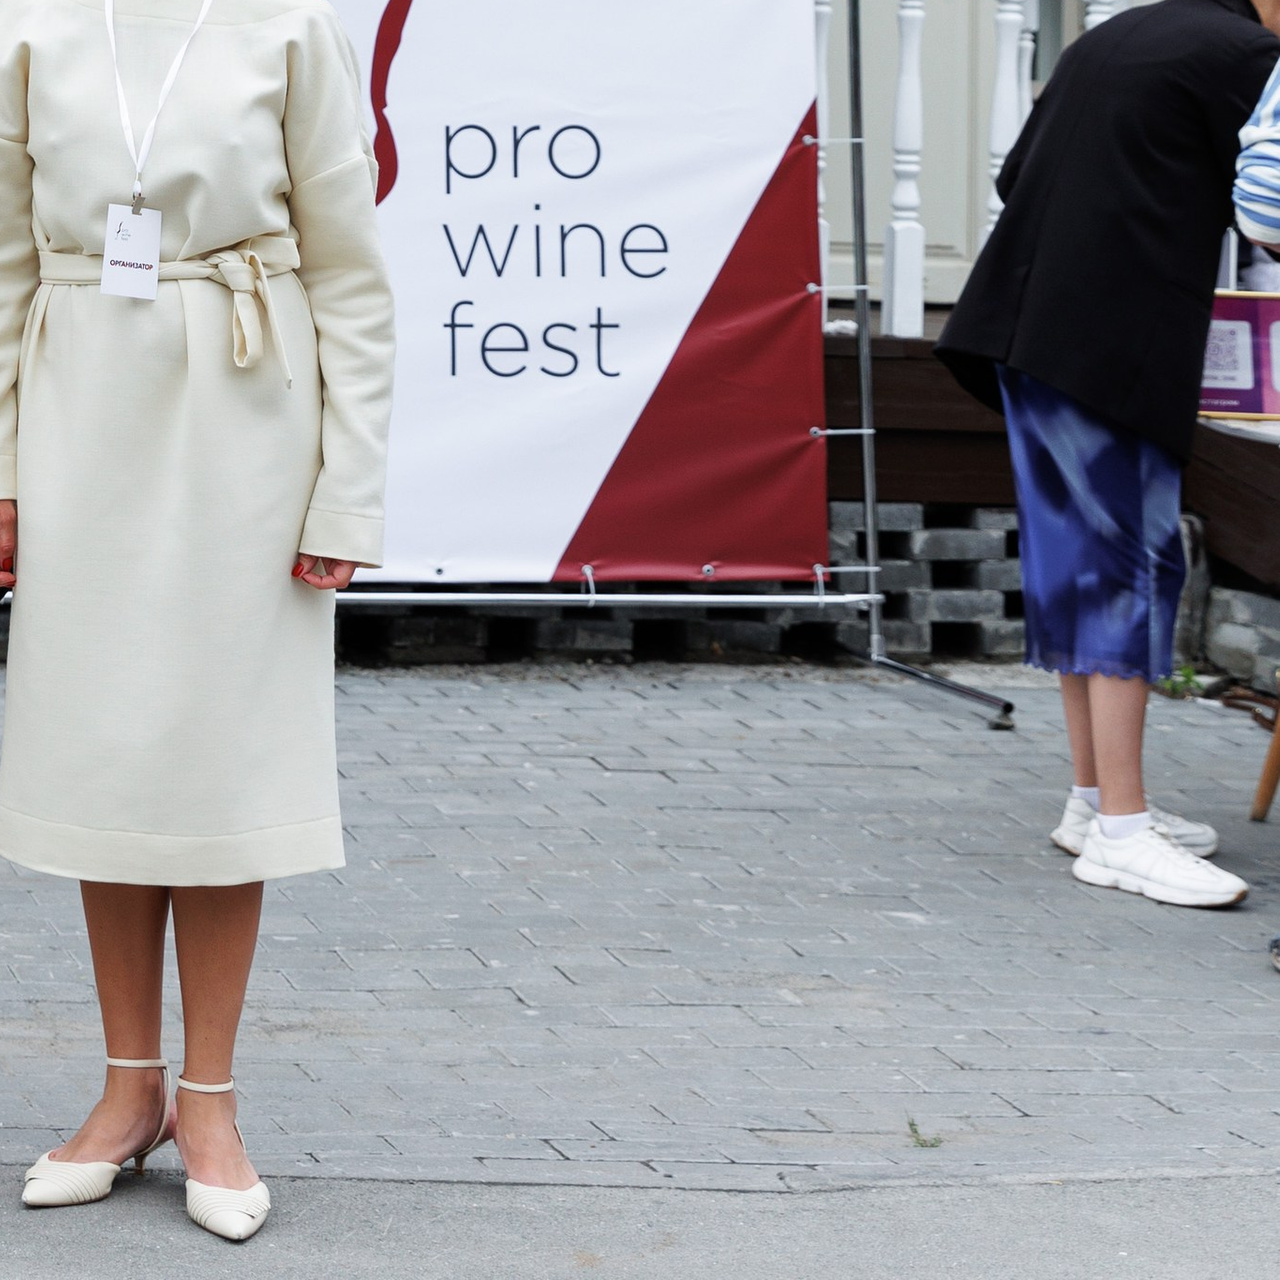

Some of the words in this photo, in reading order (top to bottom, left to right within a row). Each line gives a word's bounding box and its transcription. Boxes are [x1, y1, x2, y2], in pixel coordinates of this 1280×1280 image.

[445, 124, 601, 195] pro
[109, 259, 153, 271] ОРГАНИЗАТОР
[442, 203, 669, 279] wine
[443, 300, 620, 378] fest
